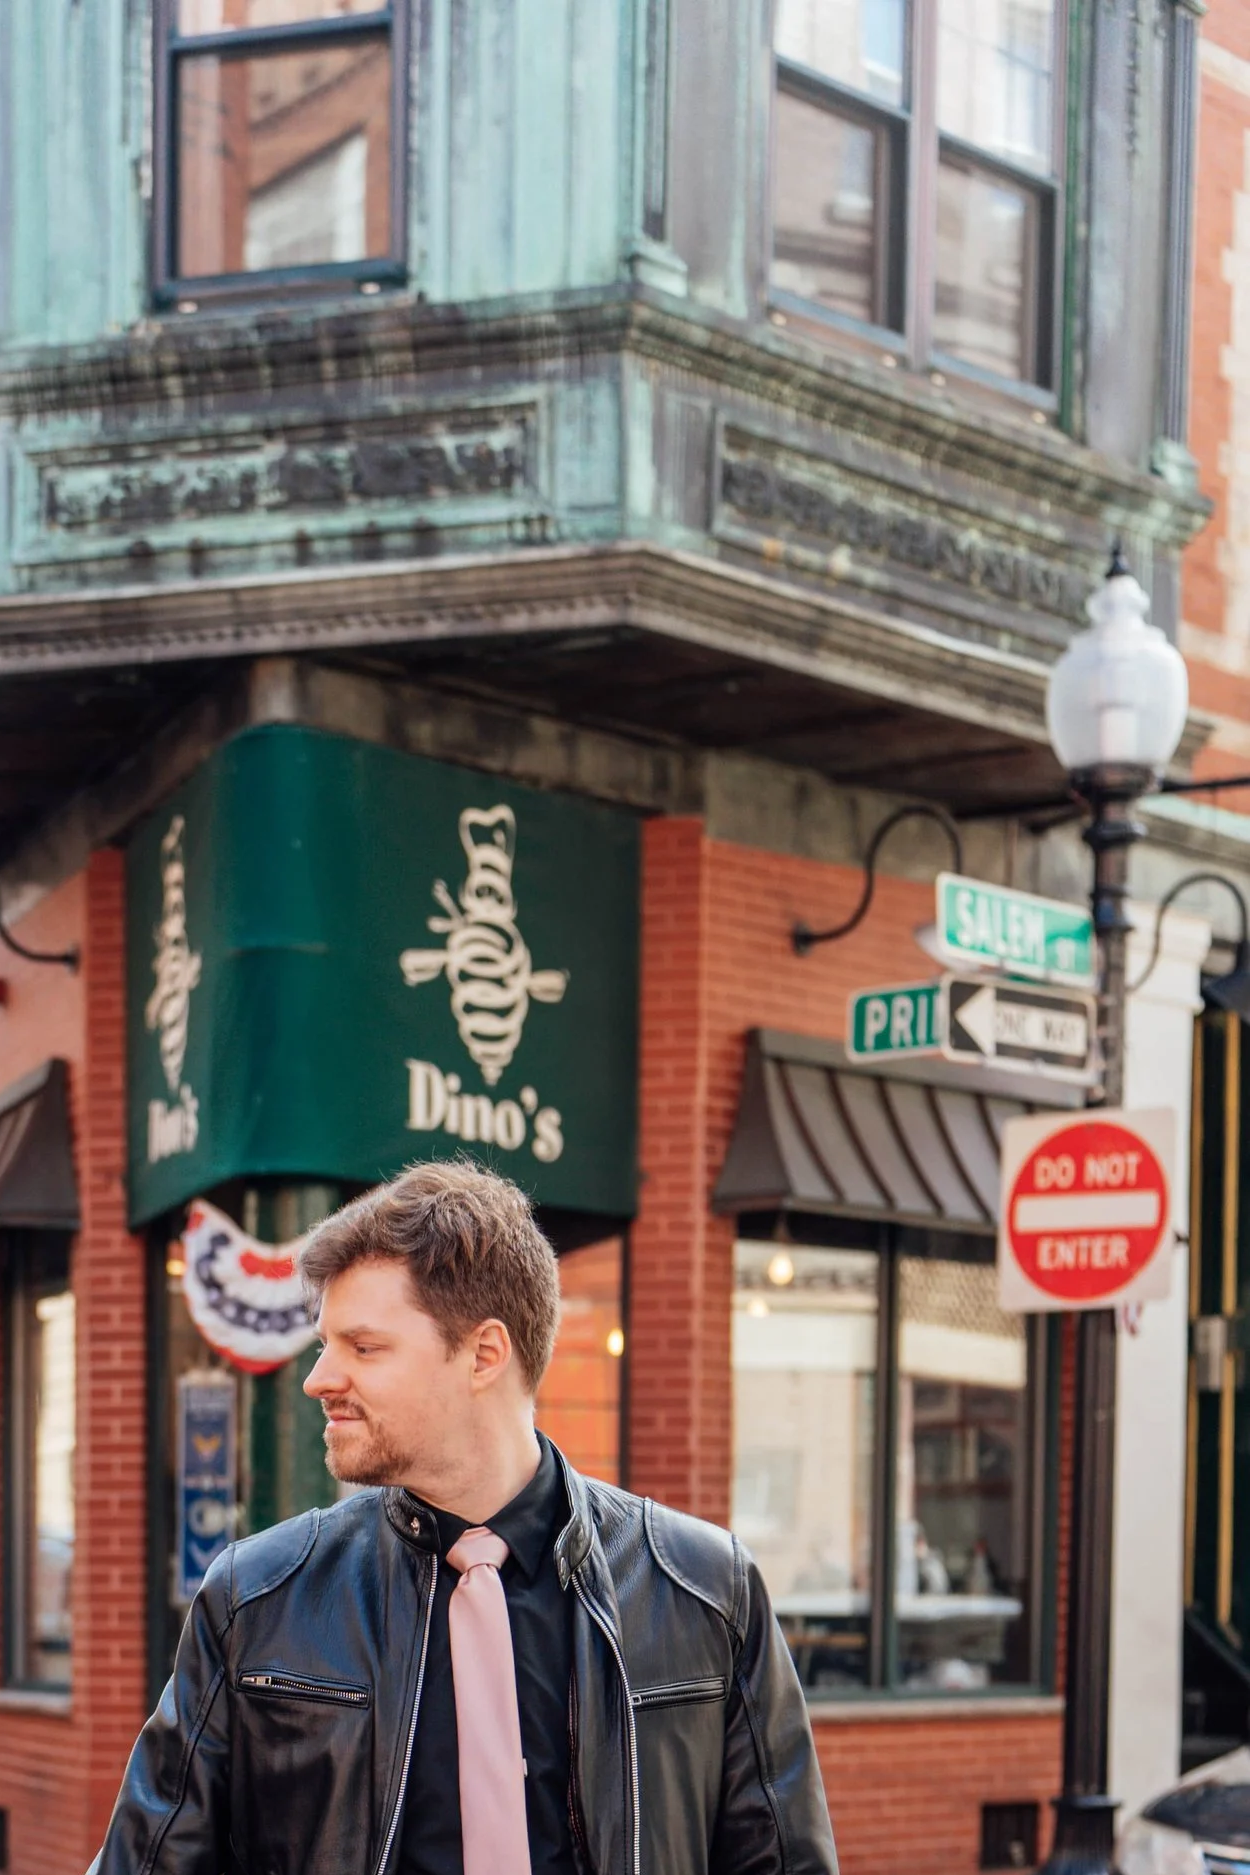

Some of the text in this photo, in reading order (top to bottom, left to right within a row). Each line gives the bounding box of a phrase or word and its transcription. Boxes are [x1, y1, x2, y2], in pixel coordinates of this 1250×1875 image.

[956, 889, 1045, 964] SALEM
[405, 1058, 564, 1163] Dino's
[1034, 1152, 1142, 1190] DO NOT
[1036, 1233, 1130, 1270] ENTER
